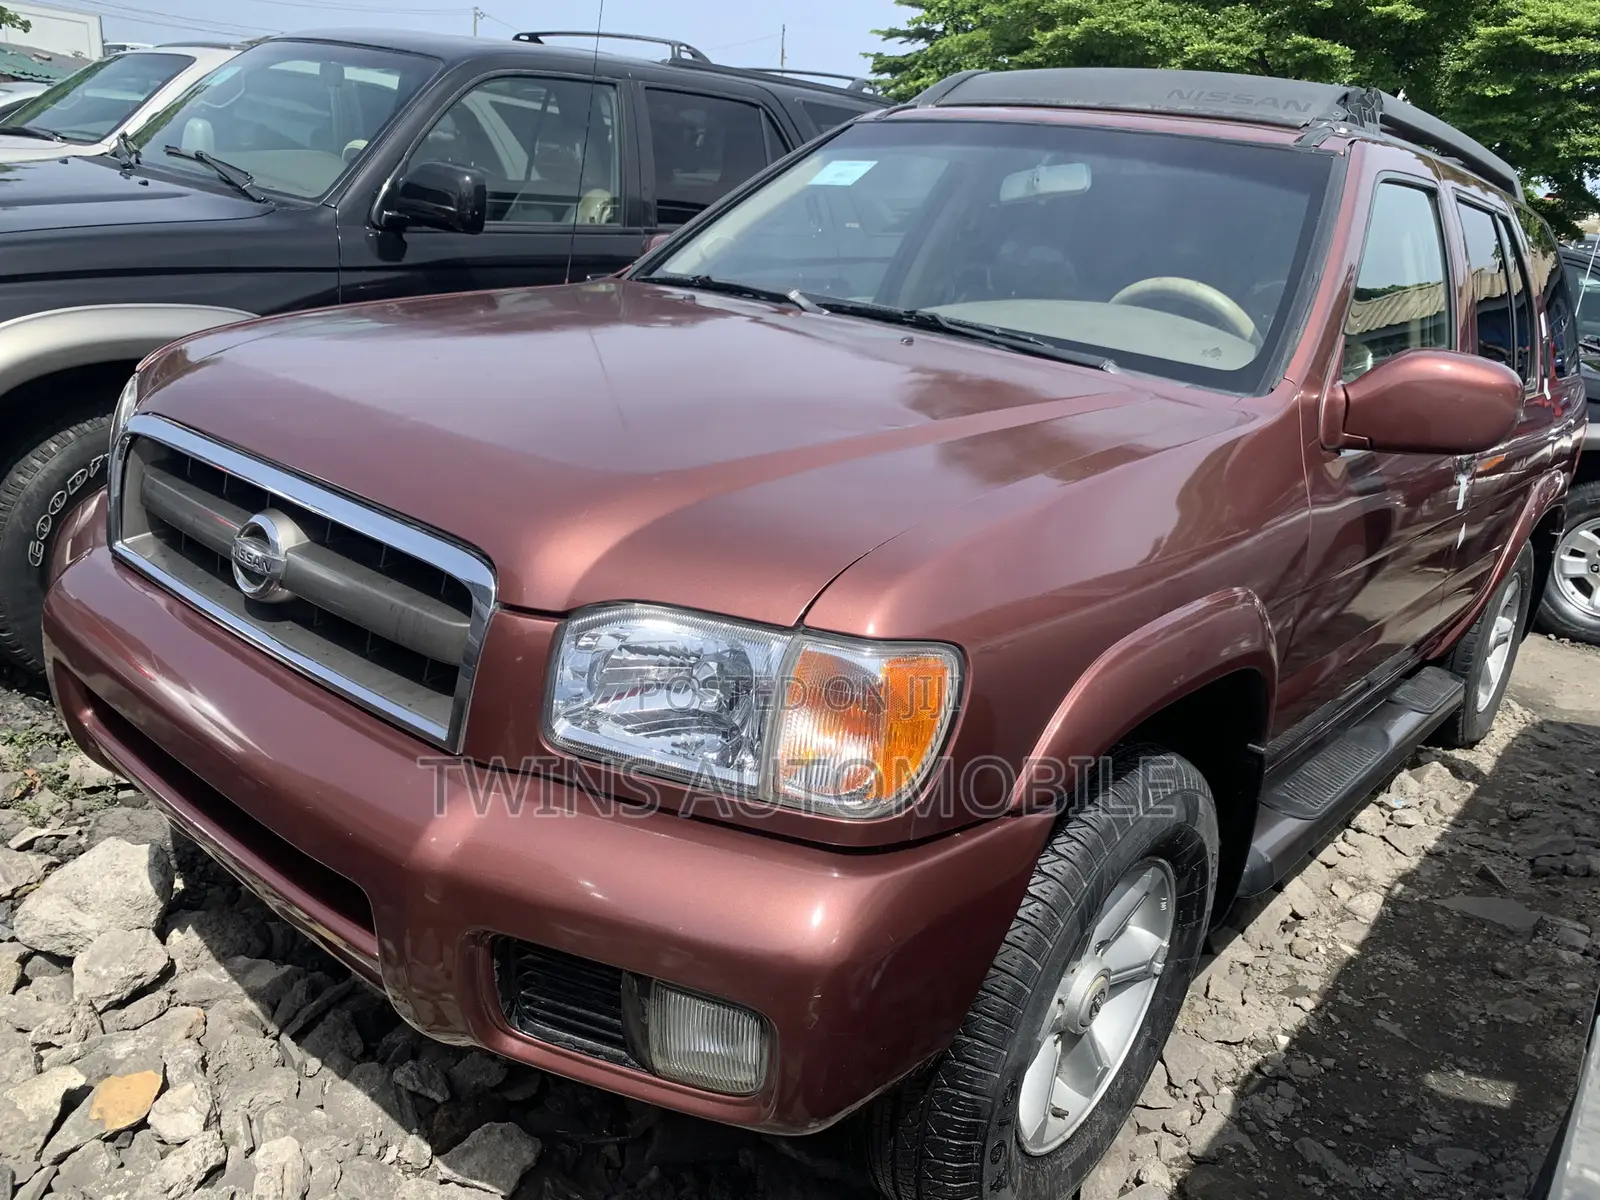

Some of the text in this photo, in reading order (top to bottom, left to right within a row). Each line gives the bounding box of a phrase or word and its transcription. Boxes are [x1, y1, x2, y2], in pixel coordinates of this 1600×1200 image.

[1166, 89, 1312, 112] NISSAN
[28, 453, 109, 567] GOOD
[233, 541, 273, 574] NISSAN
